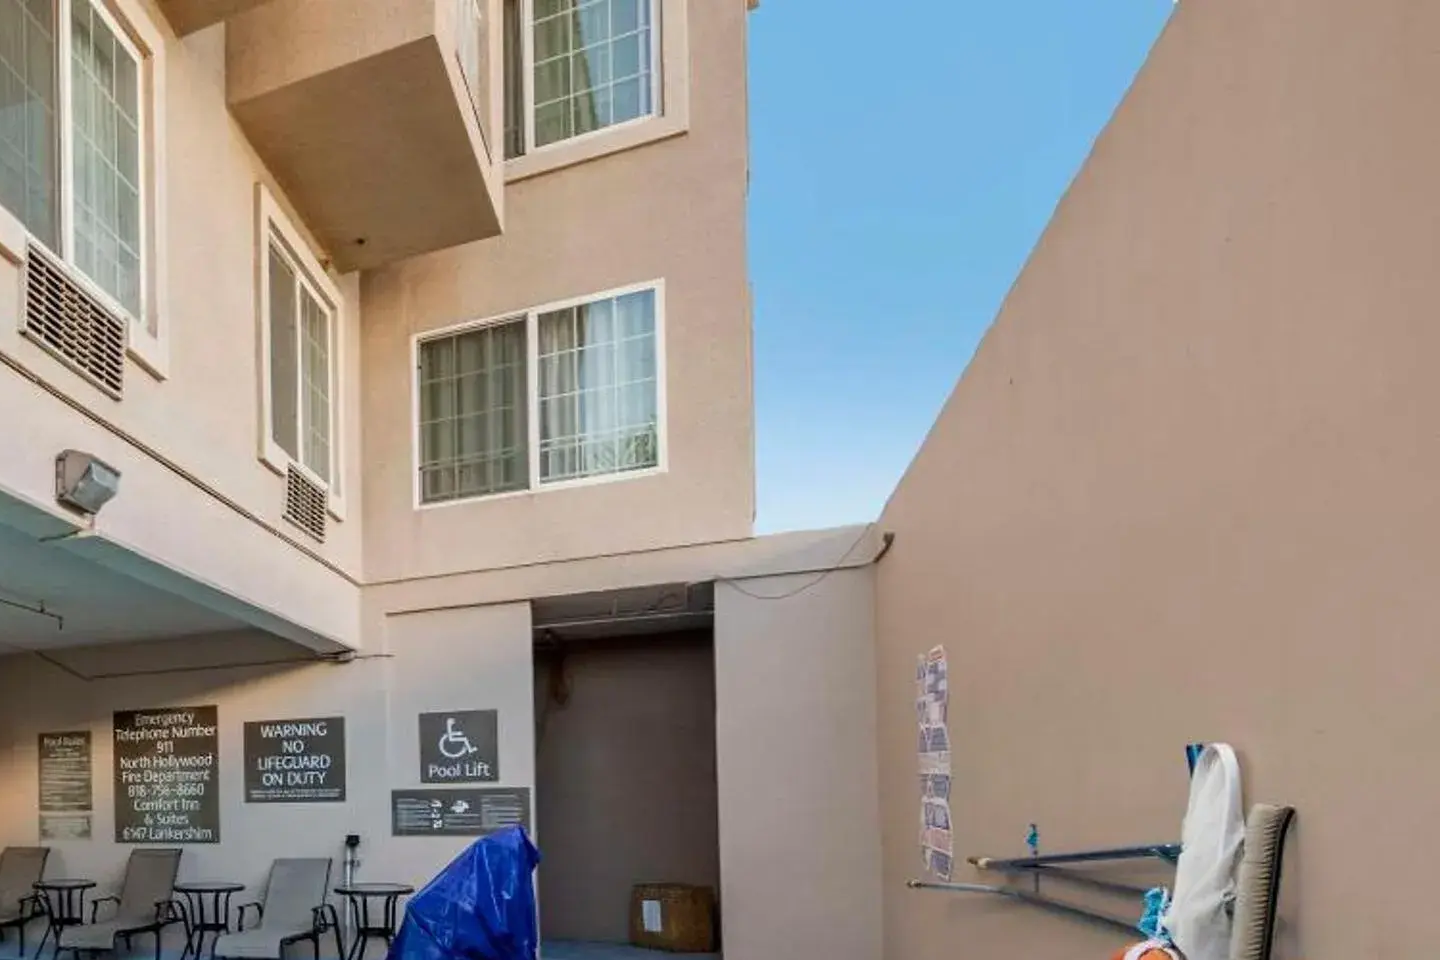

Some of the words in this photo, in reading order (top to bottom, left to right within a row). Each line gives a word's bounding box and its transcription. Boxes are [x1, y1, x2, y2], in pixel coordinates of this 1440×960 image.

[135, 712, 194, 726] Emergency
[115, 728, 170, 743] Telephone
[172, 724, 216, 738] Number
[261, 722, 327, 738] WARNING
[157, 741, 173, 753] 911
[282, 740, 304, 753] NO
[120, 756, 150, 769] North
[152, 752, 212, 768] Hollywood
[257, 754, 331, 770] LIFEGUARD
[122, 770, 141, 783] Fire
[143, 769, 211, 784] Department
[428, 763, 460, 777] Pool
[465, 761, 491, 776] Lift
[262, 773, 283, 786] ON
[287, 771, 327, 785] DUTY
[133, 799, 180, 811] Comfort
[181, 799, 200, 811] Inn
[143, 814, 153, 825] &
[156, 812, 189, 825] Suites
[149, 825, 213, 841] Lankershim
